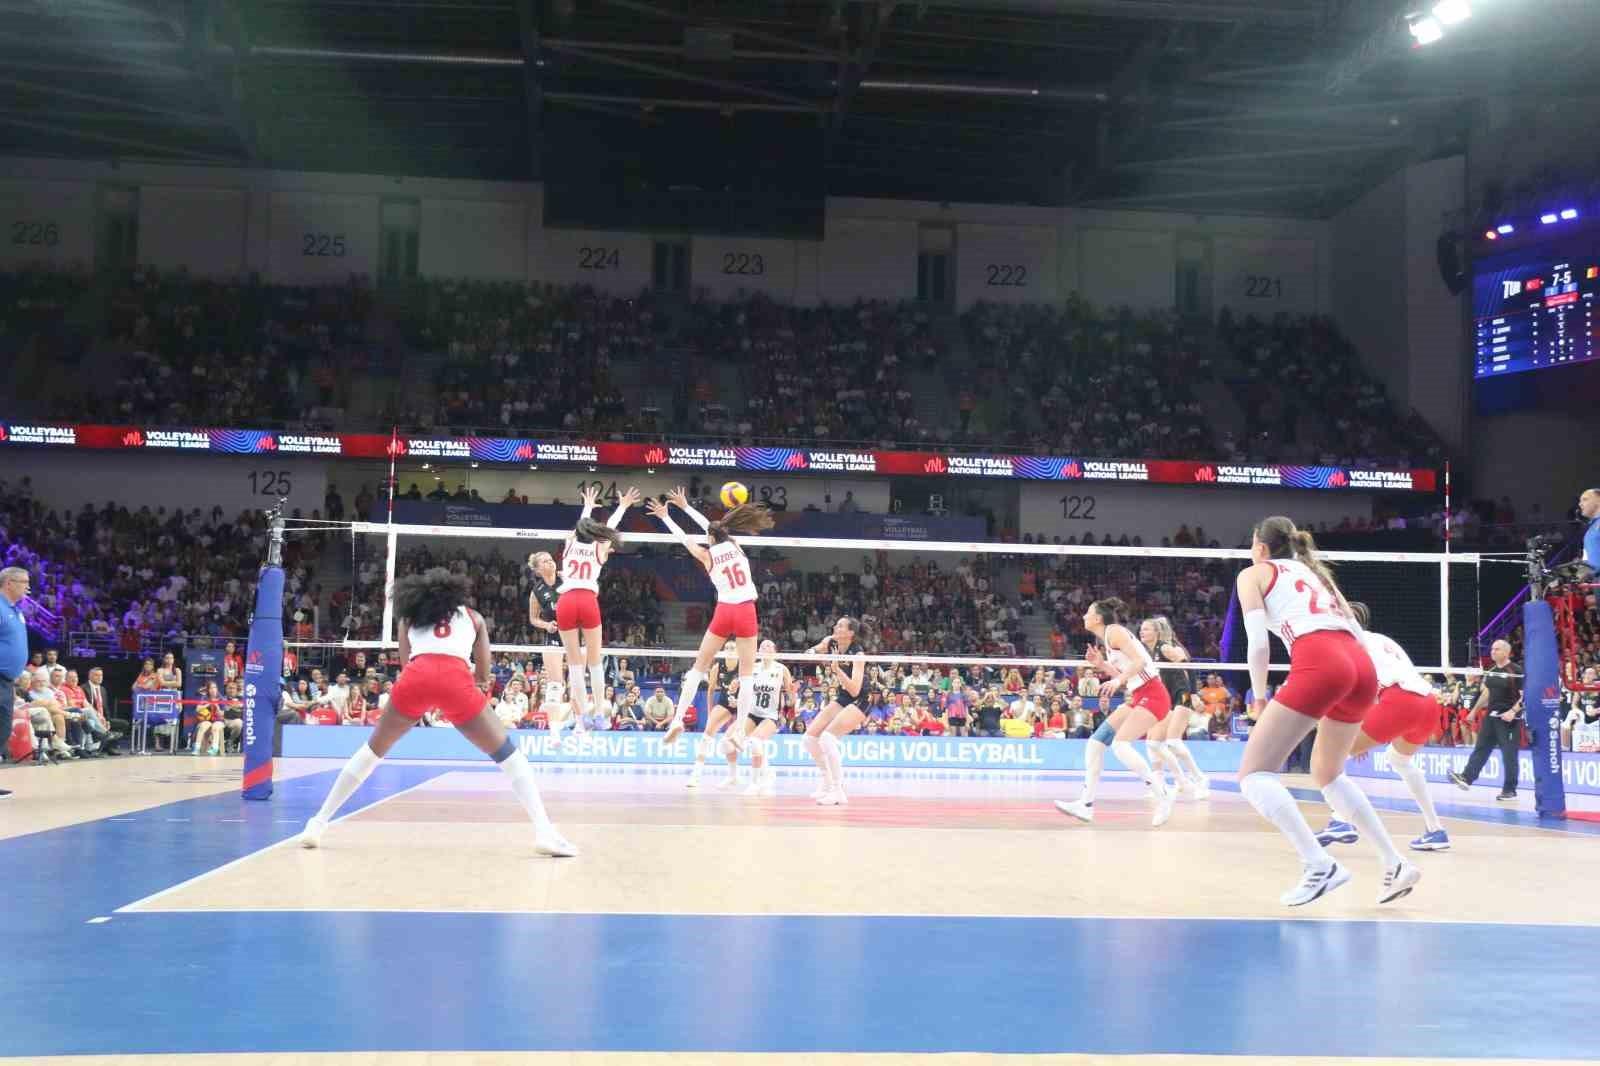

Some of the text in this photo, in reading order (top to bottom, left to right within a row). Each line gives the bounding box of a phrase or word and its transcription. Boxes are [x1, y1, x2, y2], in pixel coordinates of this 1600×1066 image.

[11, 221, 59, 246] 226
[303, 233, 346, 257] 225
[578, 247, 620, 270] 224
[723, 253, 764, 275] 223
[986, 264, 1027, 287] 222
[1244, 276, 1282, 298] 221
[10, 425, 76, 438] VOLLEYBALL
[146, 430, 210, 442] VOLLEYBALL
[10, 435, 44, 444] NATIONS
[146, 439, 210, 449] NATIONS LEAGUE
[278, 435, 342, 447] VOLLEYBALL
[409, 439, 471, 451] VOLLEYBALL
[278, 443, 341, 453] NATIONS LEAGUE
[409, 449, 470, 457] NATIONS LEAGUE
[537, 444, 599, 455] VOLLEYBALL
[669, 447, 737, 460] VOLLEYBALL
[537, 453, 598, 462] NATIONS LEAGUE
[669, 457, 737, 467] NATIONS LEAGUE
[809, 451, 876, 465] VOLLEYBALL
[947, 456, 1014, 470] VOLLEYBALL
[809, 462, 876, 472] NATIONS LEAGUE
[947, 466, 1013, 476] NATIONS LEAGUE
[1083, 461, 1148, 474] VOLLEYBALL
[1217, 465, 1281, 477] VOLLEYBALL
[1083, 471, 1148, 481] NATIONS LEAGUE
[1217, 475, 1281, 485] NATIONS LEAGUE
[1350, 470, 1413, 482] VOLLEYBALL
[247, 471, 292, 496] 125
[1350, 480, 1413, 489] NATIONS LEAGUE
[1060, 495, 1096, 519] 122
[567, 559, 593, 580] 20
[721, 562, 747, 590] 16
[755, 692, 771, 709] 18
[246, 698, 256, 745] Senoh
[520, 735, 555, 756] WE
[562, 735, 636, 757] SERVE
[642, 738, 688, 758] THE
[902, 742, 1044, 764] VOLLEYBALL
[1575, 760, 1600, 788] VO
